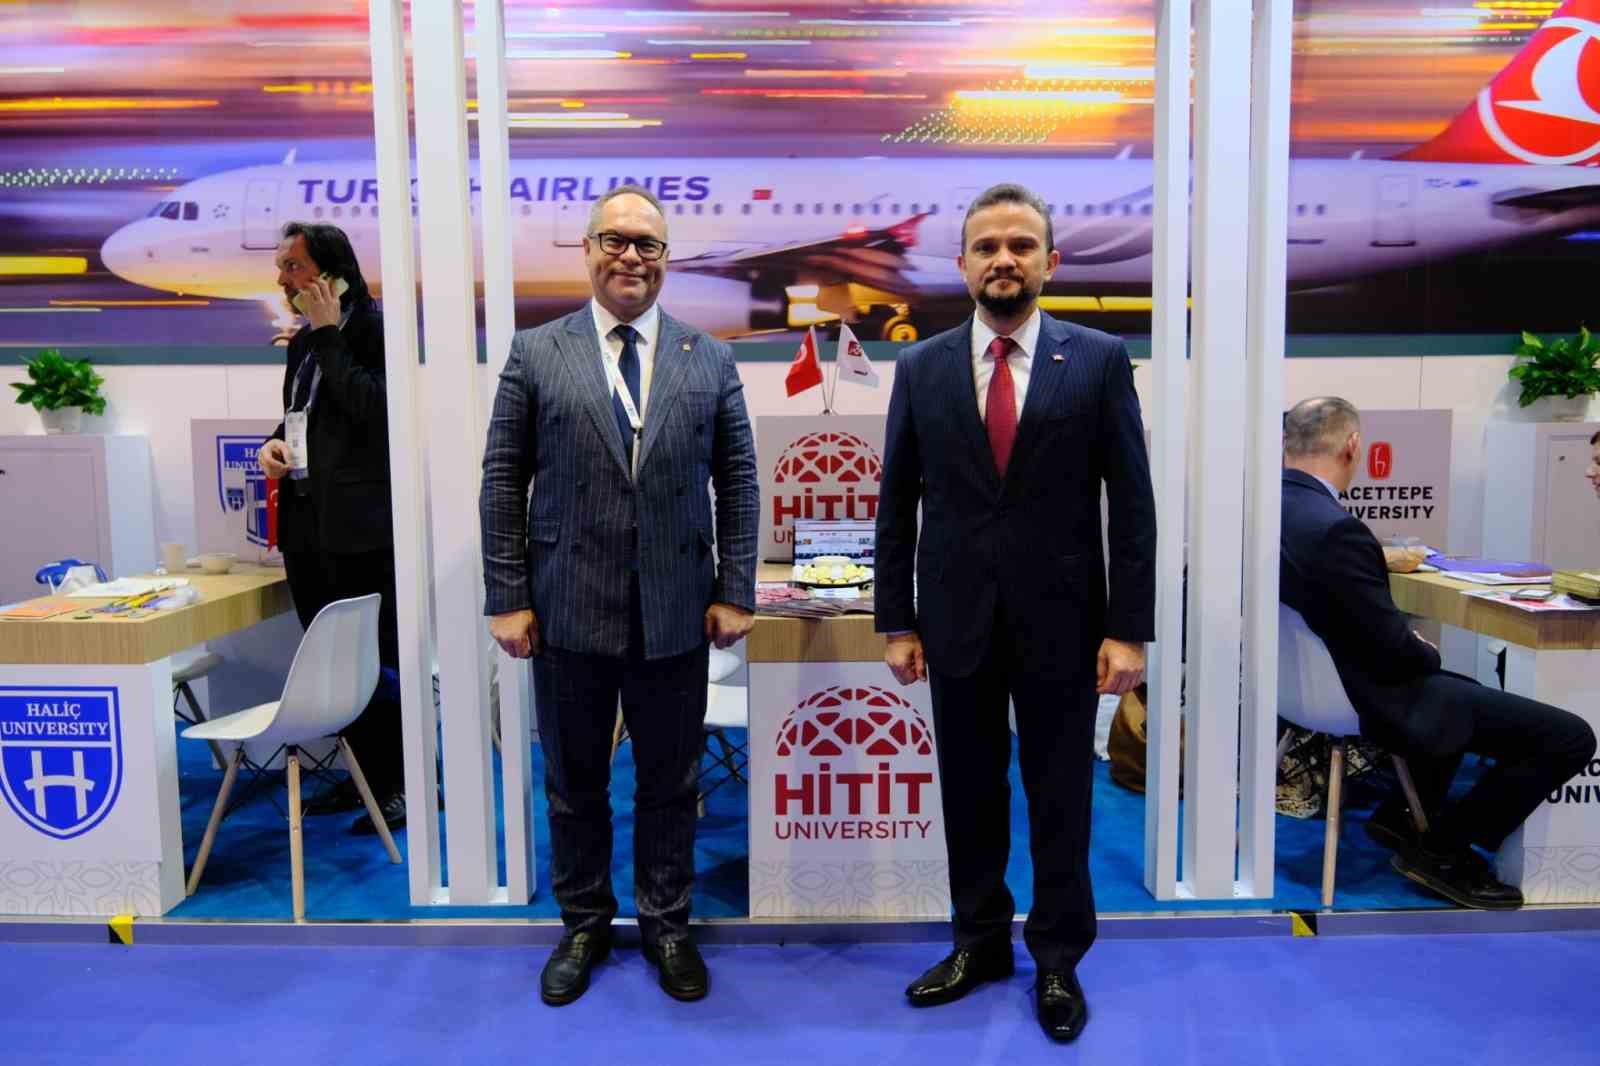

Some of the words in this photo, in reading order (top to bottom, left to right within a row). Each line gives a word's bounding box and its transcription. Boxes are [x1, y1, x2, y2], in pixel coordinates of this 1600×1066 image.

[298, 178, 481, 203] TURH
[1338, 486, 1433, 500] ACETTEPE
[1344, 505, 1434, 519] IVERSITY
[26, 701, 81, 720] HALİÇ
[1, 721, 109, 736] UNIVERSITY
[775, 762, 932, 816] HİTİT
[775, 820, 932, 840] UNIVERSITY
